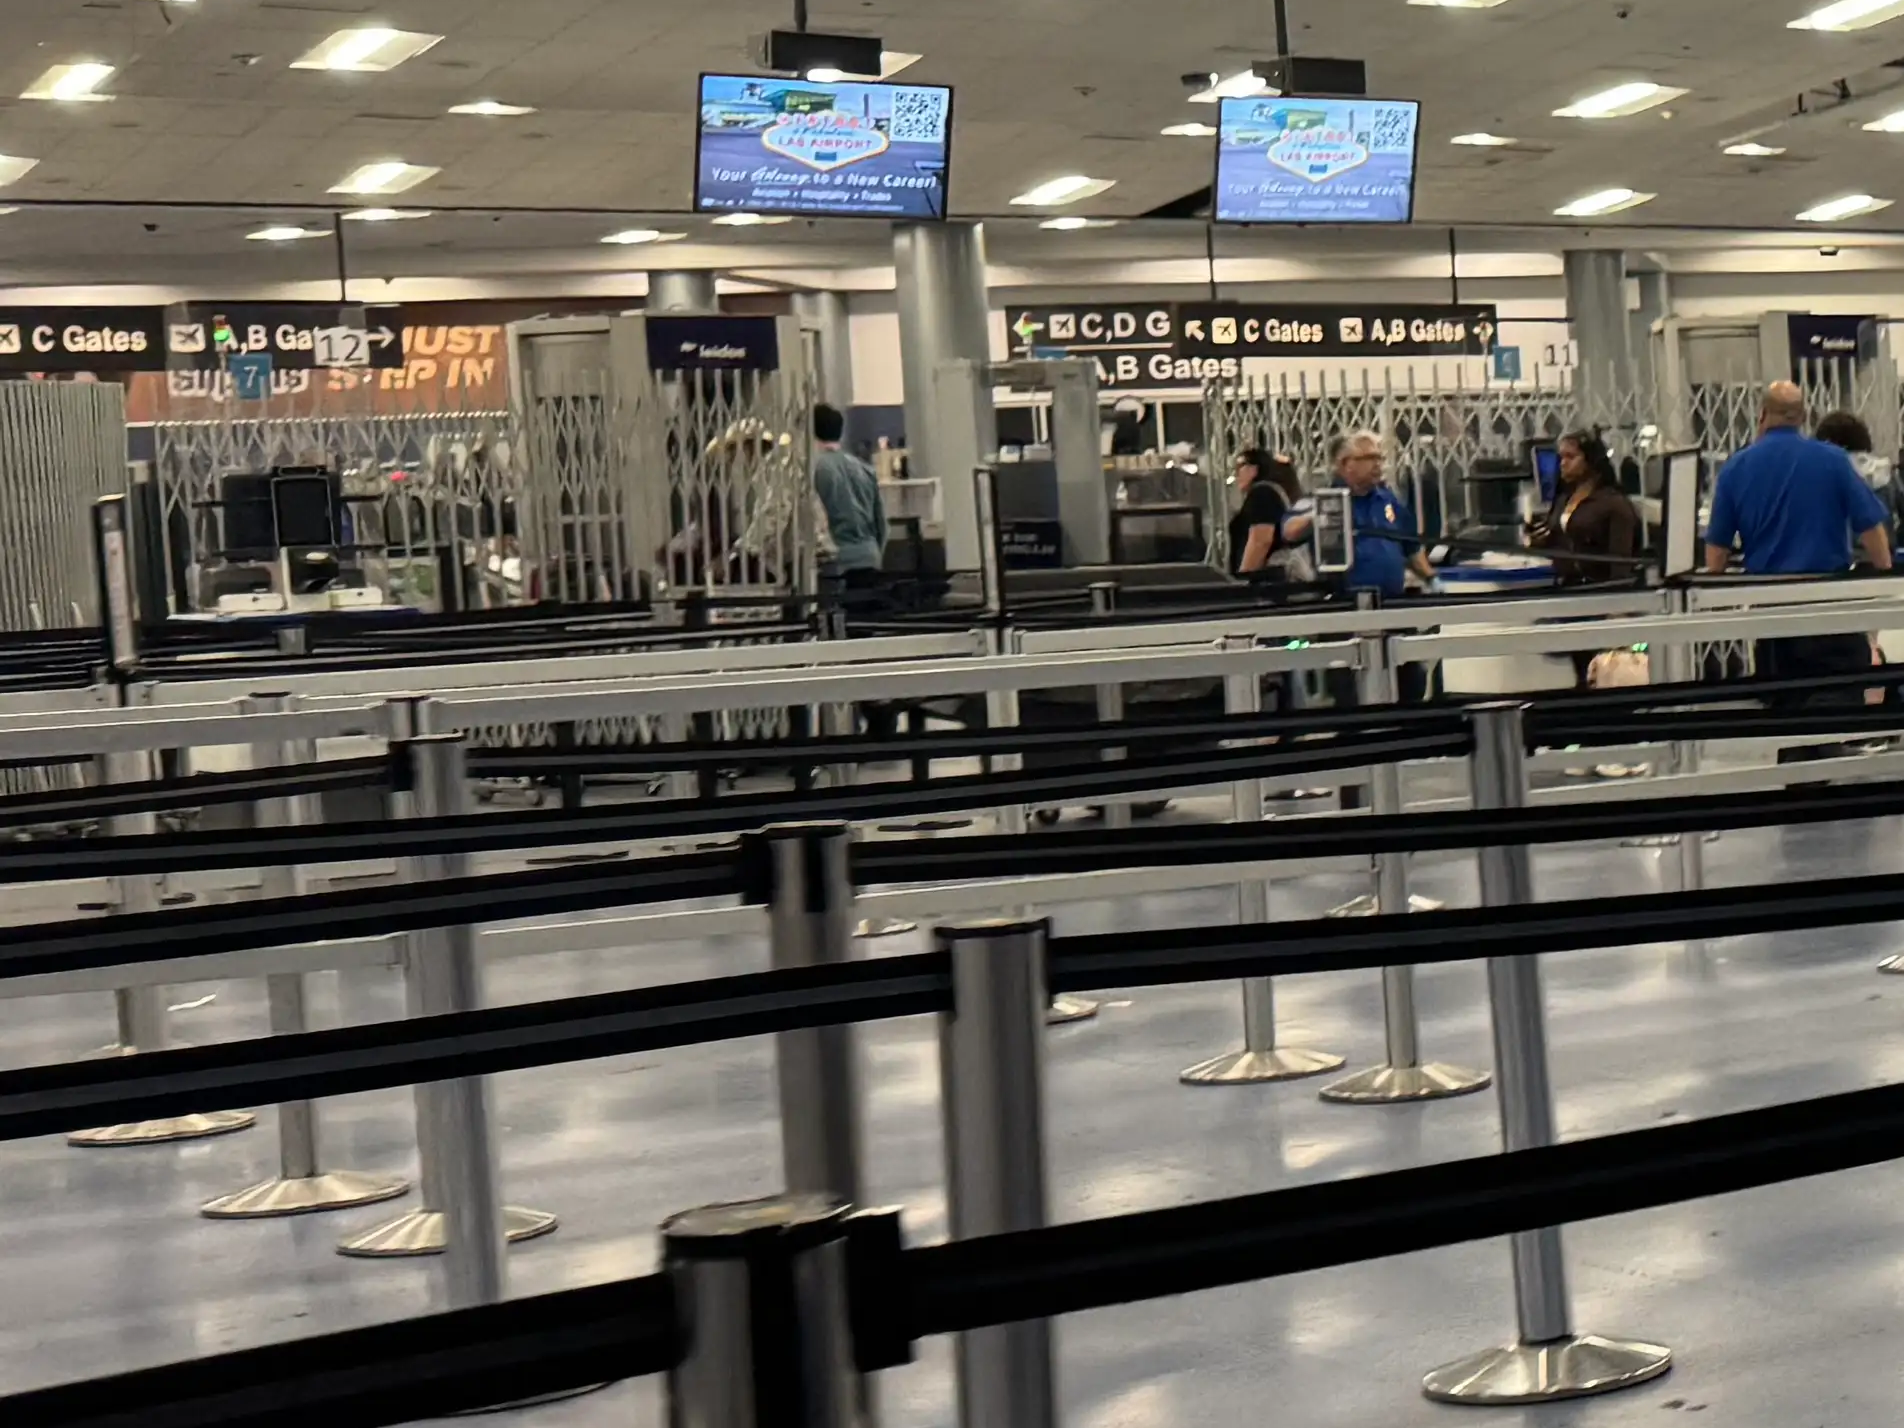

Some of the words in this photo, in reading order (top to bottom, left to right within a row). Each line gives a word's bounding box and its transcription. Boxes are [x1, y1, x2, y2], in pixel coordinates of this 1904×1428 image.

[849, 173, 878, 186] New
[32, 325, 56, 353] C
[62, 325, 148, 352] Gates
[1080, 312, 1137, 343] C,D
[1243, 319, 1260, 343] C
[1265, 318, 1324, 343] Gates
[1371, 318, 1406, 346] A,B
[1410, 318, 1466, 343] Gates
[320, 333, 364, 361] 12
[1545, 343, 1573, 367] 11
[244, 366, 258, 388] 7
[1148, 353, 1239, 380] Gates
